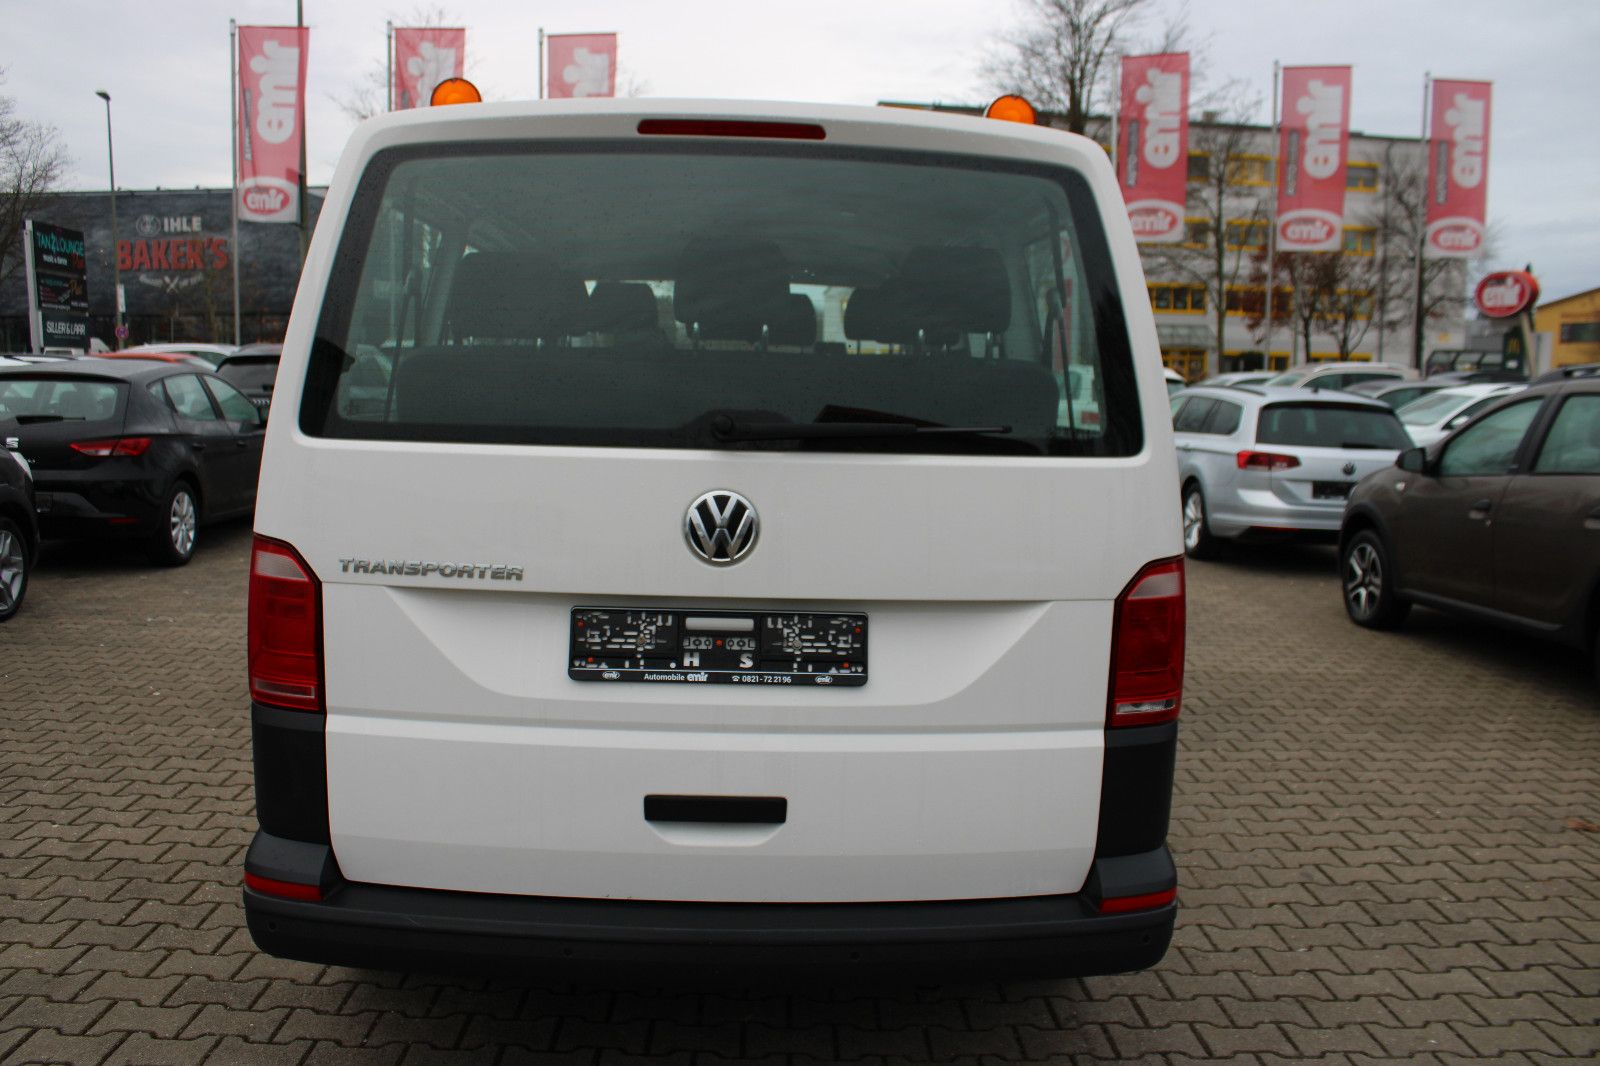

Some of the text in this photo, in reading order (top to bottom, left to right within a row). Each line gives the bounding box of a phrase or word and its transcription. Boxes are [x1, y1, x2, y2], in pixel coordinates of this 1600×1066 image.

[250, 40, 300, 144] emir
[1135, 67, 1182, 168] emir
[1296, 80, 1344, 179] emir
[1444, 93, 1485, 188] emir
[246, 189, 284, 211] emir
[163, 215, 202, 233] IHLE
[116, 236, 229, 270] BAKER'S
[339, 558, 524, 581] TRANSPORTER
[643, 672, 709, 682] Automobile emir
